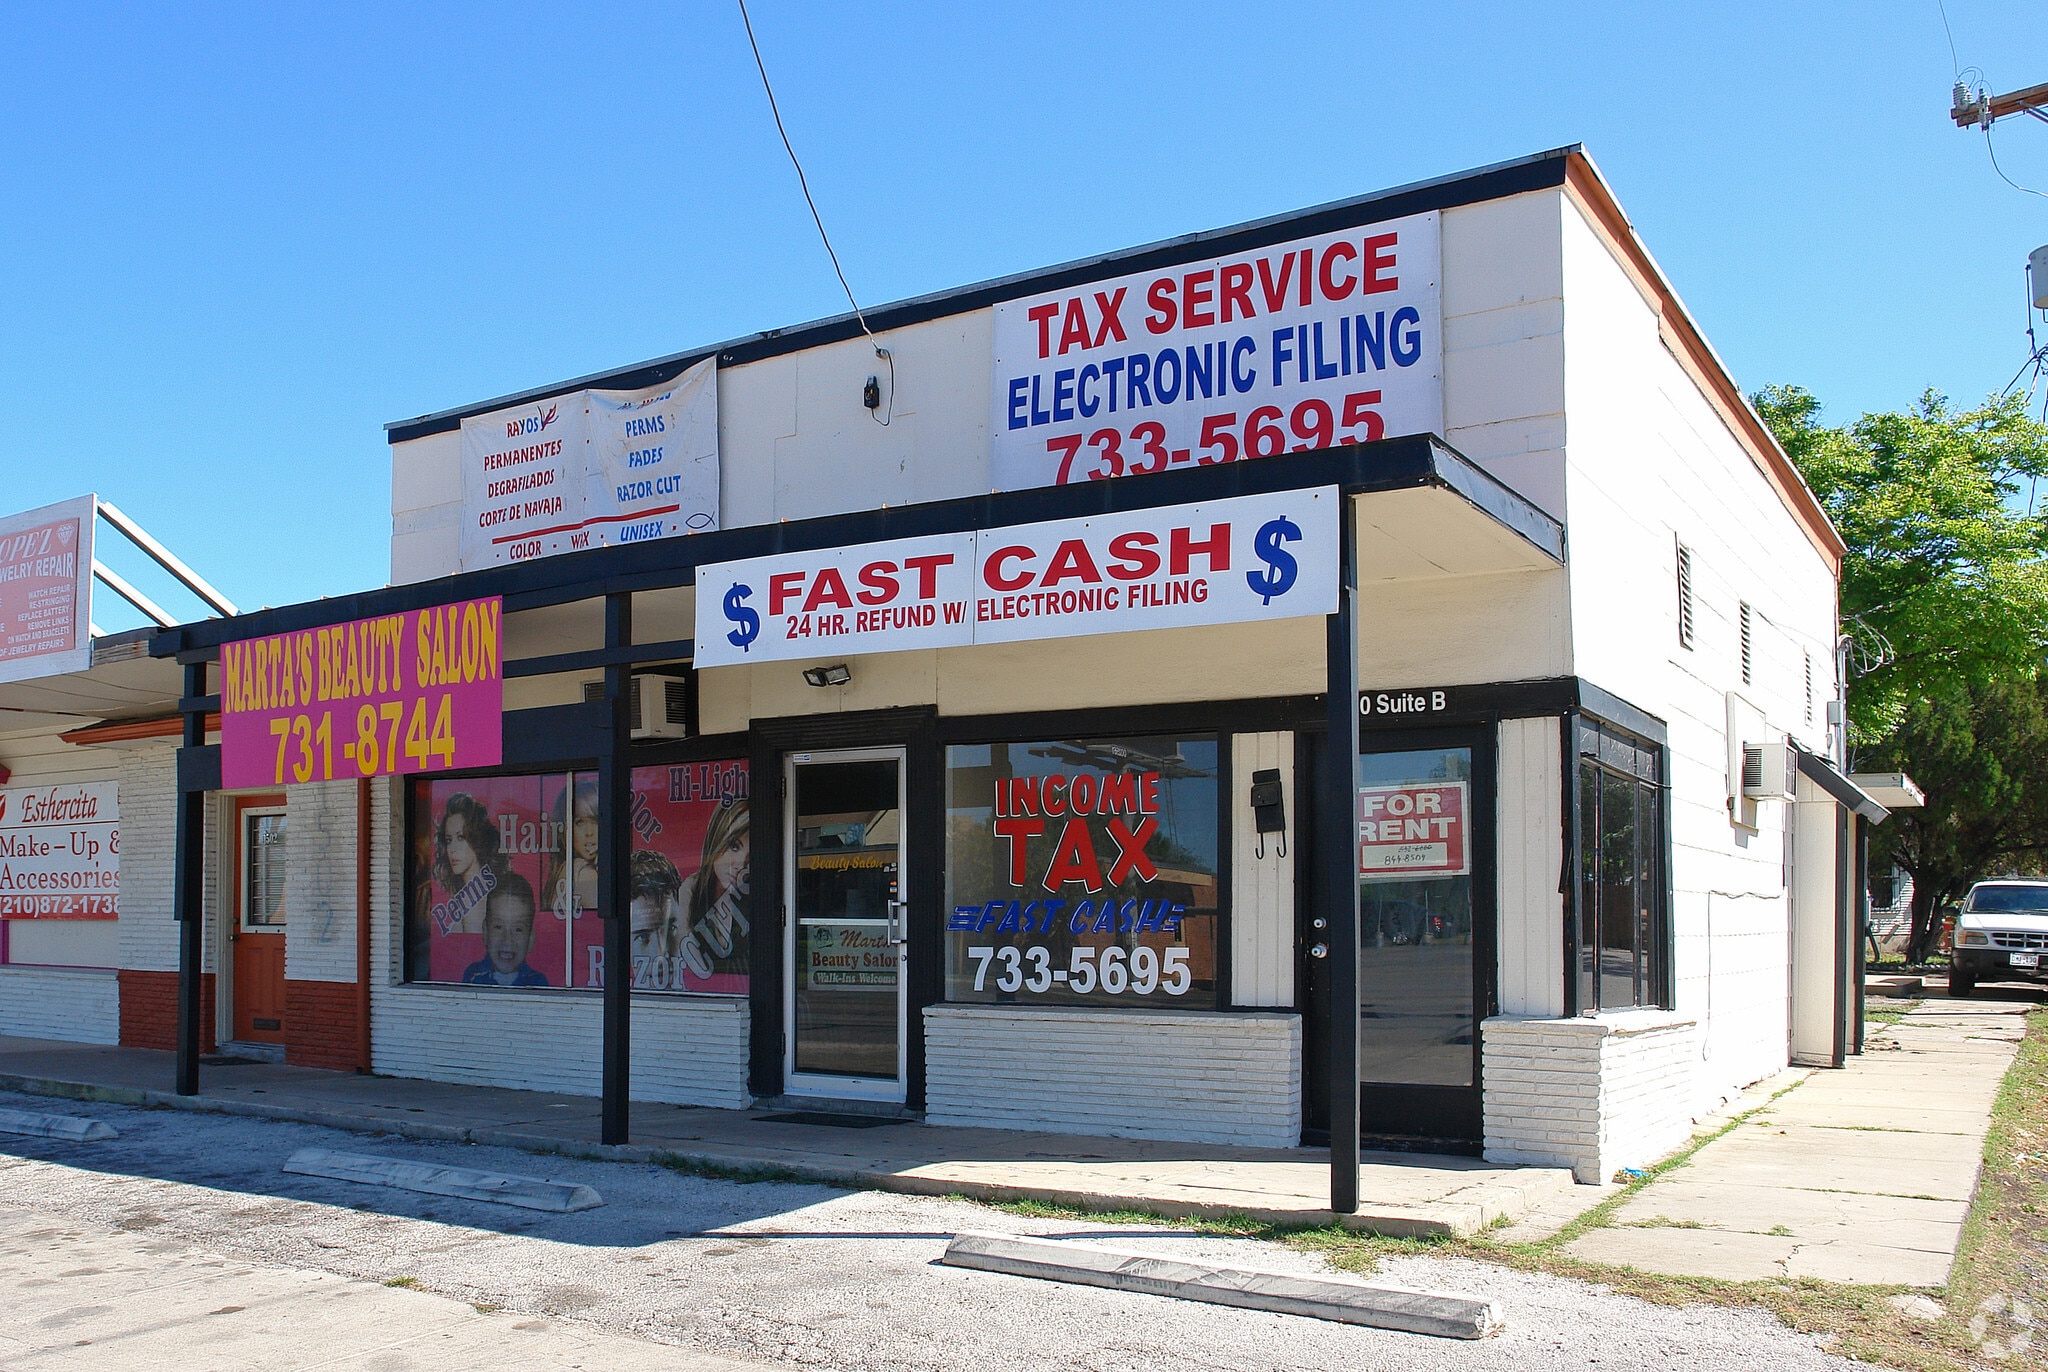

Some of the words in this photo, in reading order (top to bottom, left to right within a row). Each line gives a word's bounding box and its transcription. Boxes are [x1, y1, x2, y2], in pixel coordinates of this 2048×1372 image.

[1028, 287, 1127, 359] TAX
[1145, 232, 1399, 335] SERVICE
[1008, 335, 1257, 430] ELECTRONIC
[1272, 306, 1421, 387] FILING
[507, 416, 539, 438] RAYOS
[625, 415, 665, 438] PERMS
[1046, 389, 1385, 486] 733-5695
[484, 439, 562, 471] PERMANENTES
[628, 447, 663, 468] FADES
[487, 469, 555, 498] DEGRAFILADOS
[616, 480, 652, 503] RAZOR
[656, 475, 681, 495] CUT
[479, 508, 507, 527] CORTE
[509, 504, 521, 521] DE
[524, 497, 562, 518] NAVAJA
[509, 541, 542, 560] COLOR
[620, 520, 663, 542] UNISEX
[35, 552, 73, 578] REPAIR
[722, 580, 760, 653] $
[768, 553, 955, 616] FAST
[983, 522, 1232, 591] CASH
[1246, 514, 1303, 606] $
[786, 614, 812, 640] 24
[817, 612, 850, 637] HR.
[855, 603, 937, 633] REFUND
[942, 600, 968, 625] W/
[977, 587, 1119, 623] ELECTRONIC
[1128, 579, 1209, 608] FILING
[224, 631, 313, 714] MARTA'S
[317, 615, 405, 701] BEAUTY
[416, 600, 499, 689] SALON
[1376, 693, 1426, 714] Suite
[1432, 691, 1446, 711] B
[270, 693, 455, 784] 731-8744
[668, 764, 749, 809] Hi-Ligh
[995, 771, 1160, 817] INCOME
[1363, 792, 1442, 817] FOR
[22, 787, 98, 823] Esthercita
[497, 812, 564, 855] Hair
[1359, 817, 1456, 842] RENT
[810, 855, 850, 873] Beauty
[852, 856, 884, 869] Salon
[994, 817, 1159, 894] TAX
[0, 861, 119, 890] Accessories
[431, 864, 497, 937] Perms
[975, 900, 1066, 934] FAST
[1069, 899, 1171, 935] CASH
[812, 951, 860, 970] Beauty
[816, 972, 856, 984] Walk-Ins
[859, 972, 897, 984] Welcome
[968, 946, 1192, 995] 733-5695
